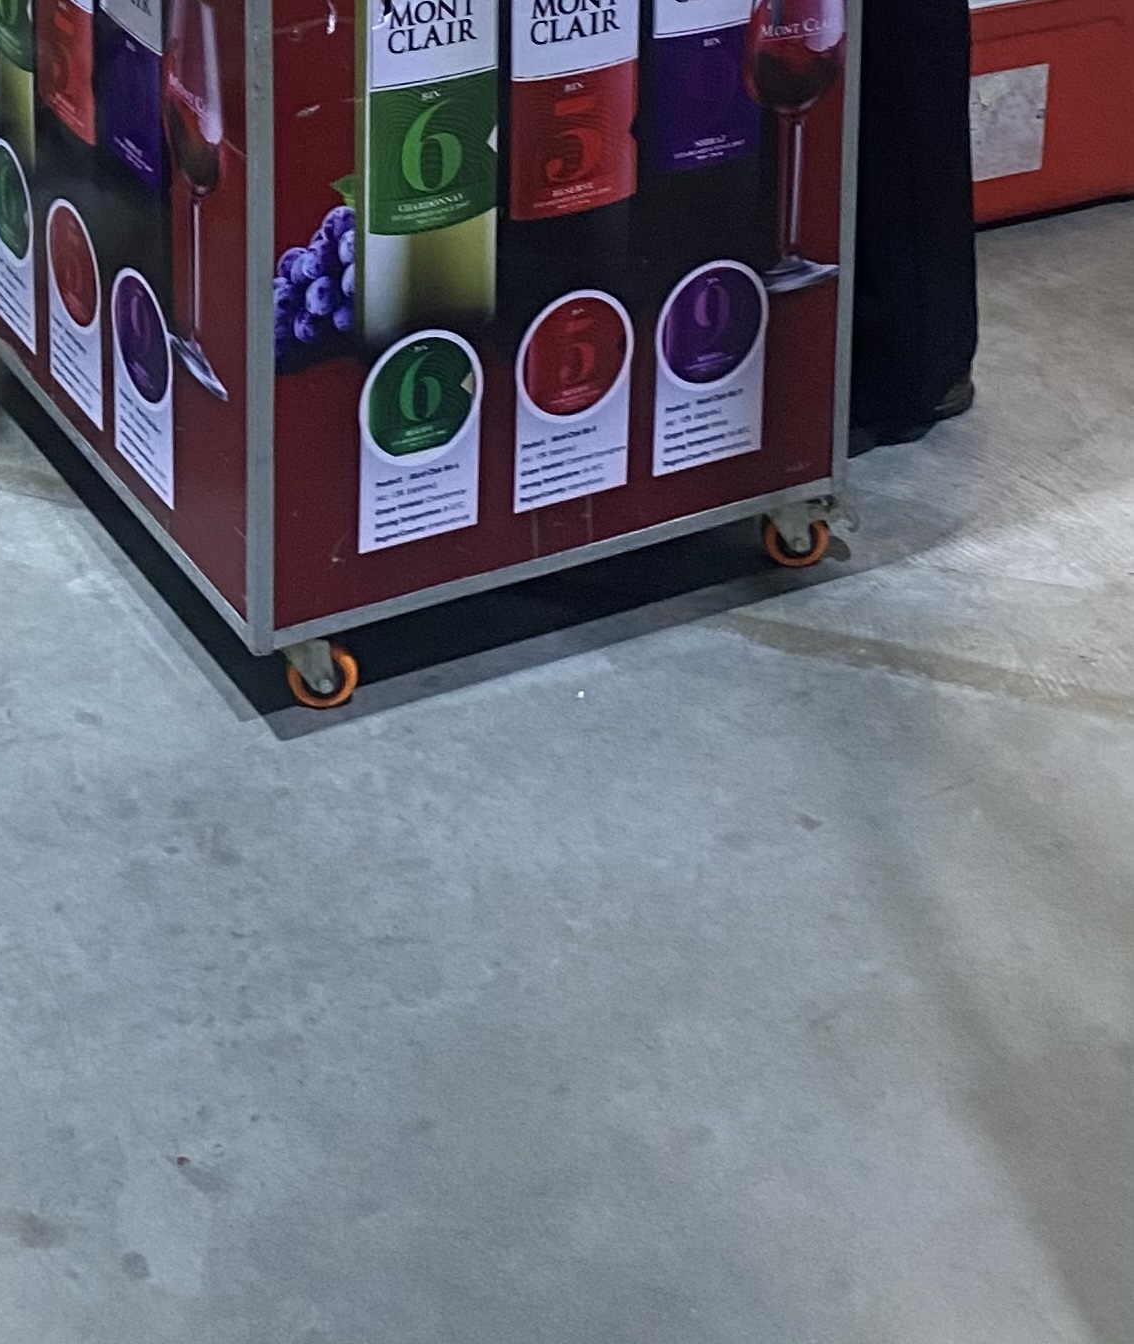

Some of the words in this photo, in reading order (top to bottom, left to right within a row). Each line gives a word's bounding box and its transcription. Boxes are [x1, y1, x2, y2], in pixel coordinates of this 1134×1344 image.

[387, 18, 478, 55] CLAIR
[530, 8, 622, 46] CLAIR
[401, 98, 463, 193] 6
[546, 95, 602, 184] 5
[399, 351, 442, 423] 6
